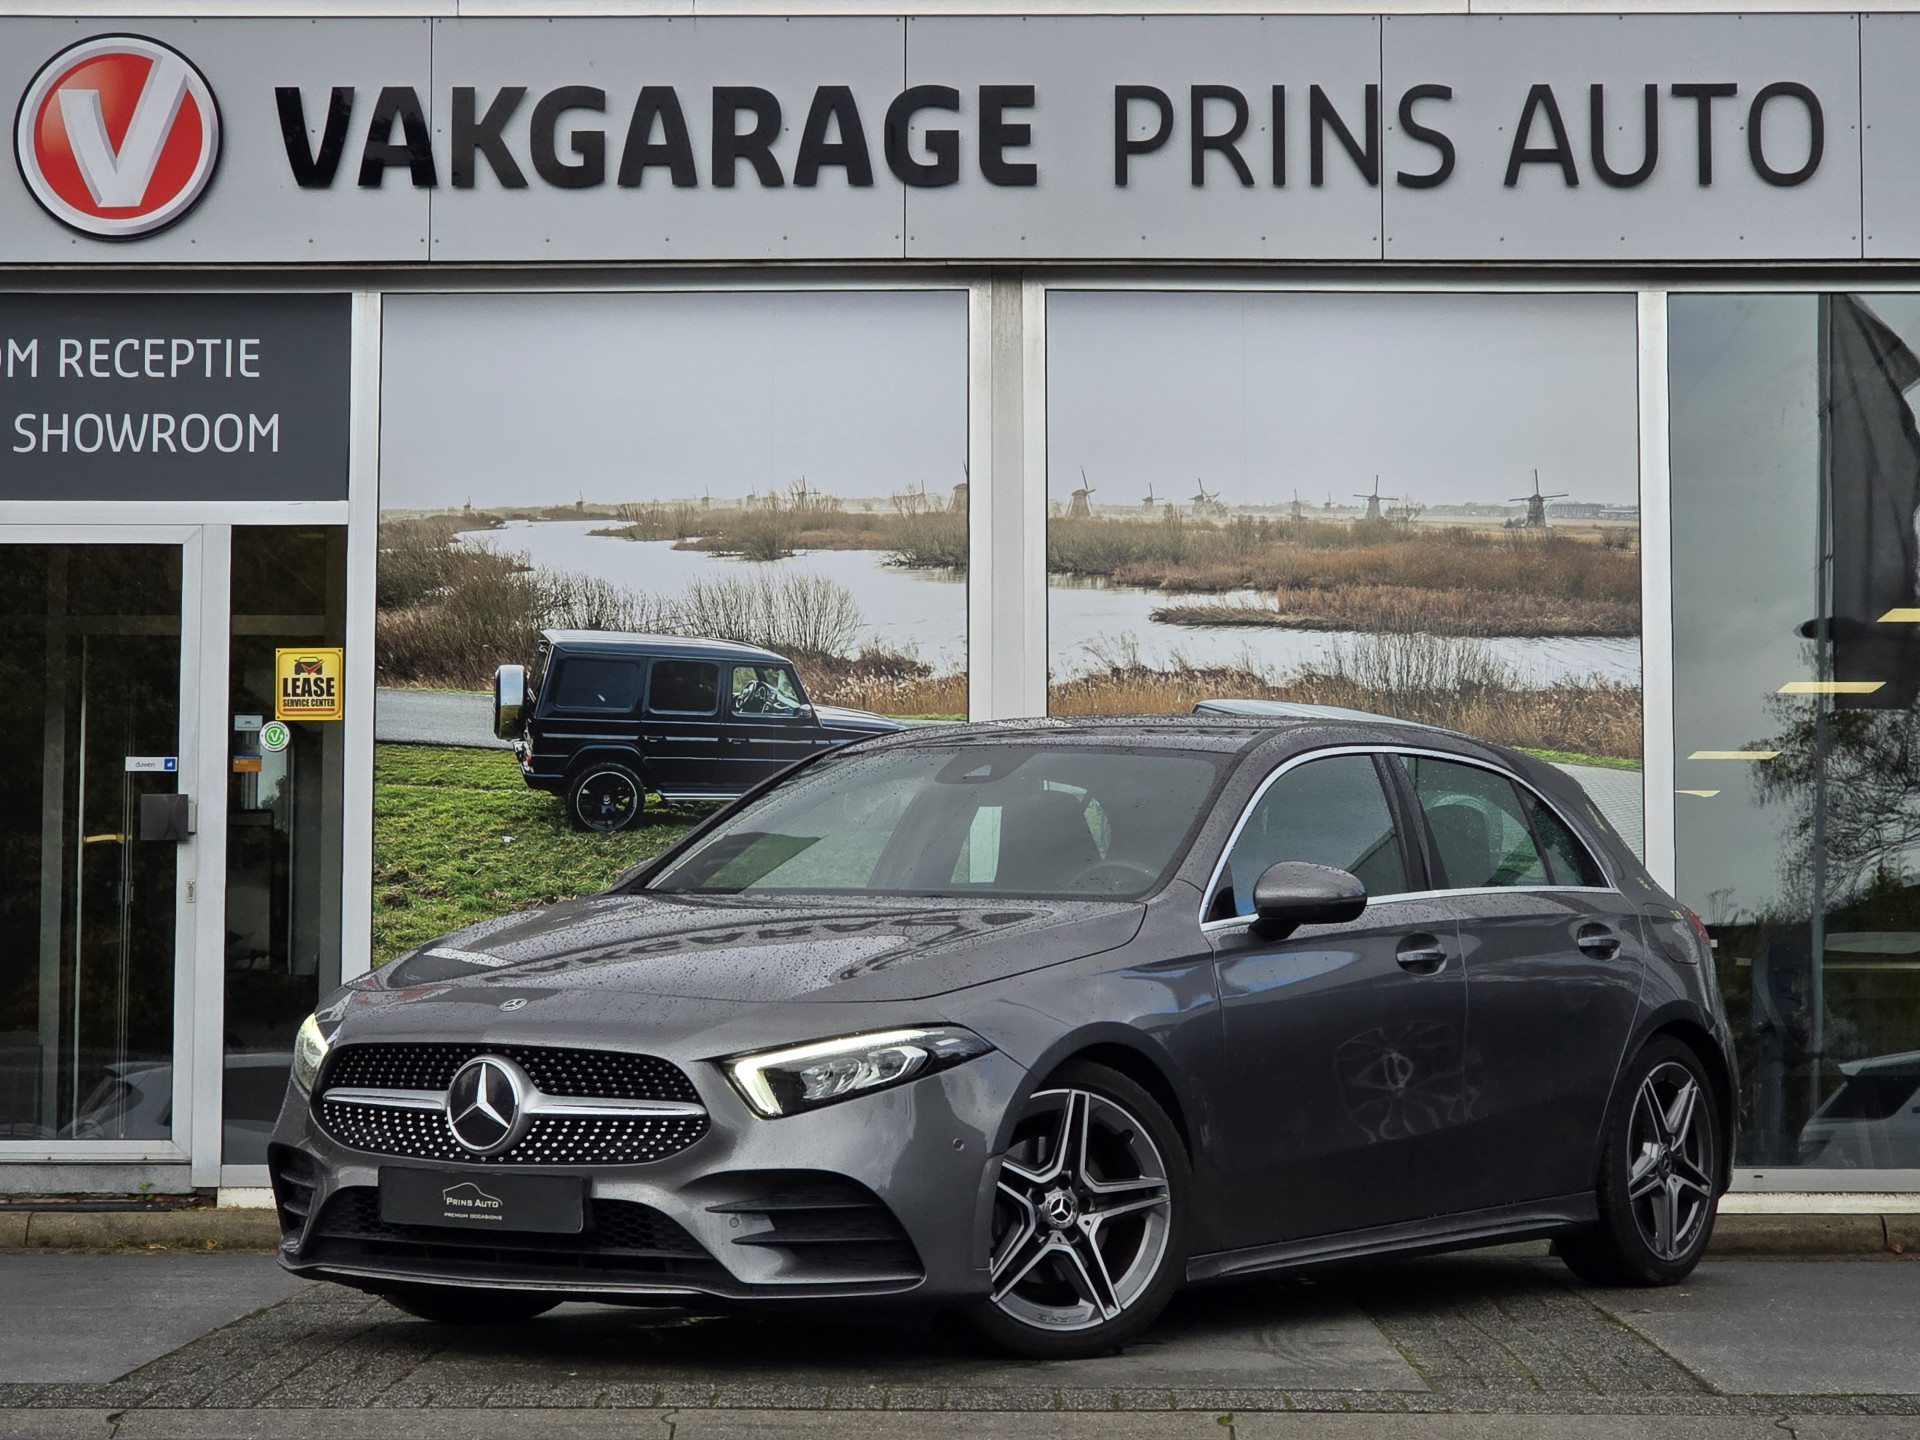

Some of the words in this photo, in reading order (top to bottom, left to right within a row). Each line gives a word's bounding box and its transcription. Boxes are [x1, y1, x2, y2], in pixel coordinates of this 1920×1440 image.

[275, 85, 1038, 190] VAKGARAGE
[1115, 84, 1455, 189] PRINS
[1504, 82, 1825, 190] AUTO
[60, 338, 260, 379] RECEPTIE
[13, 413, 279, 453] SHOWROOM
[282, 677, 335, 697] LEASE
[282, 698, 310, 708] SERVICE
[311, 698, 335, 707] CENTER
[475, 1199, 499, 1208] AUTO
